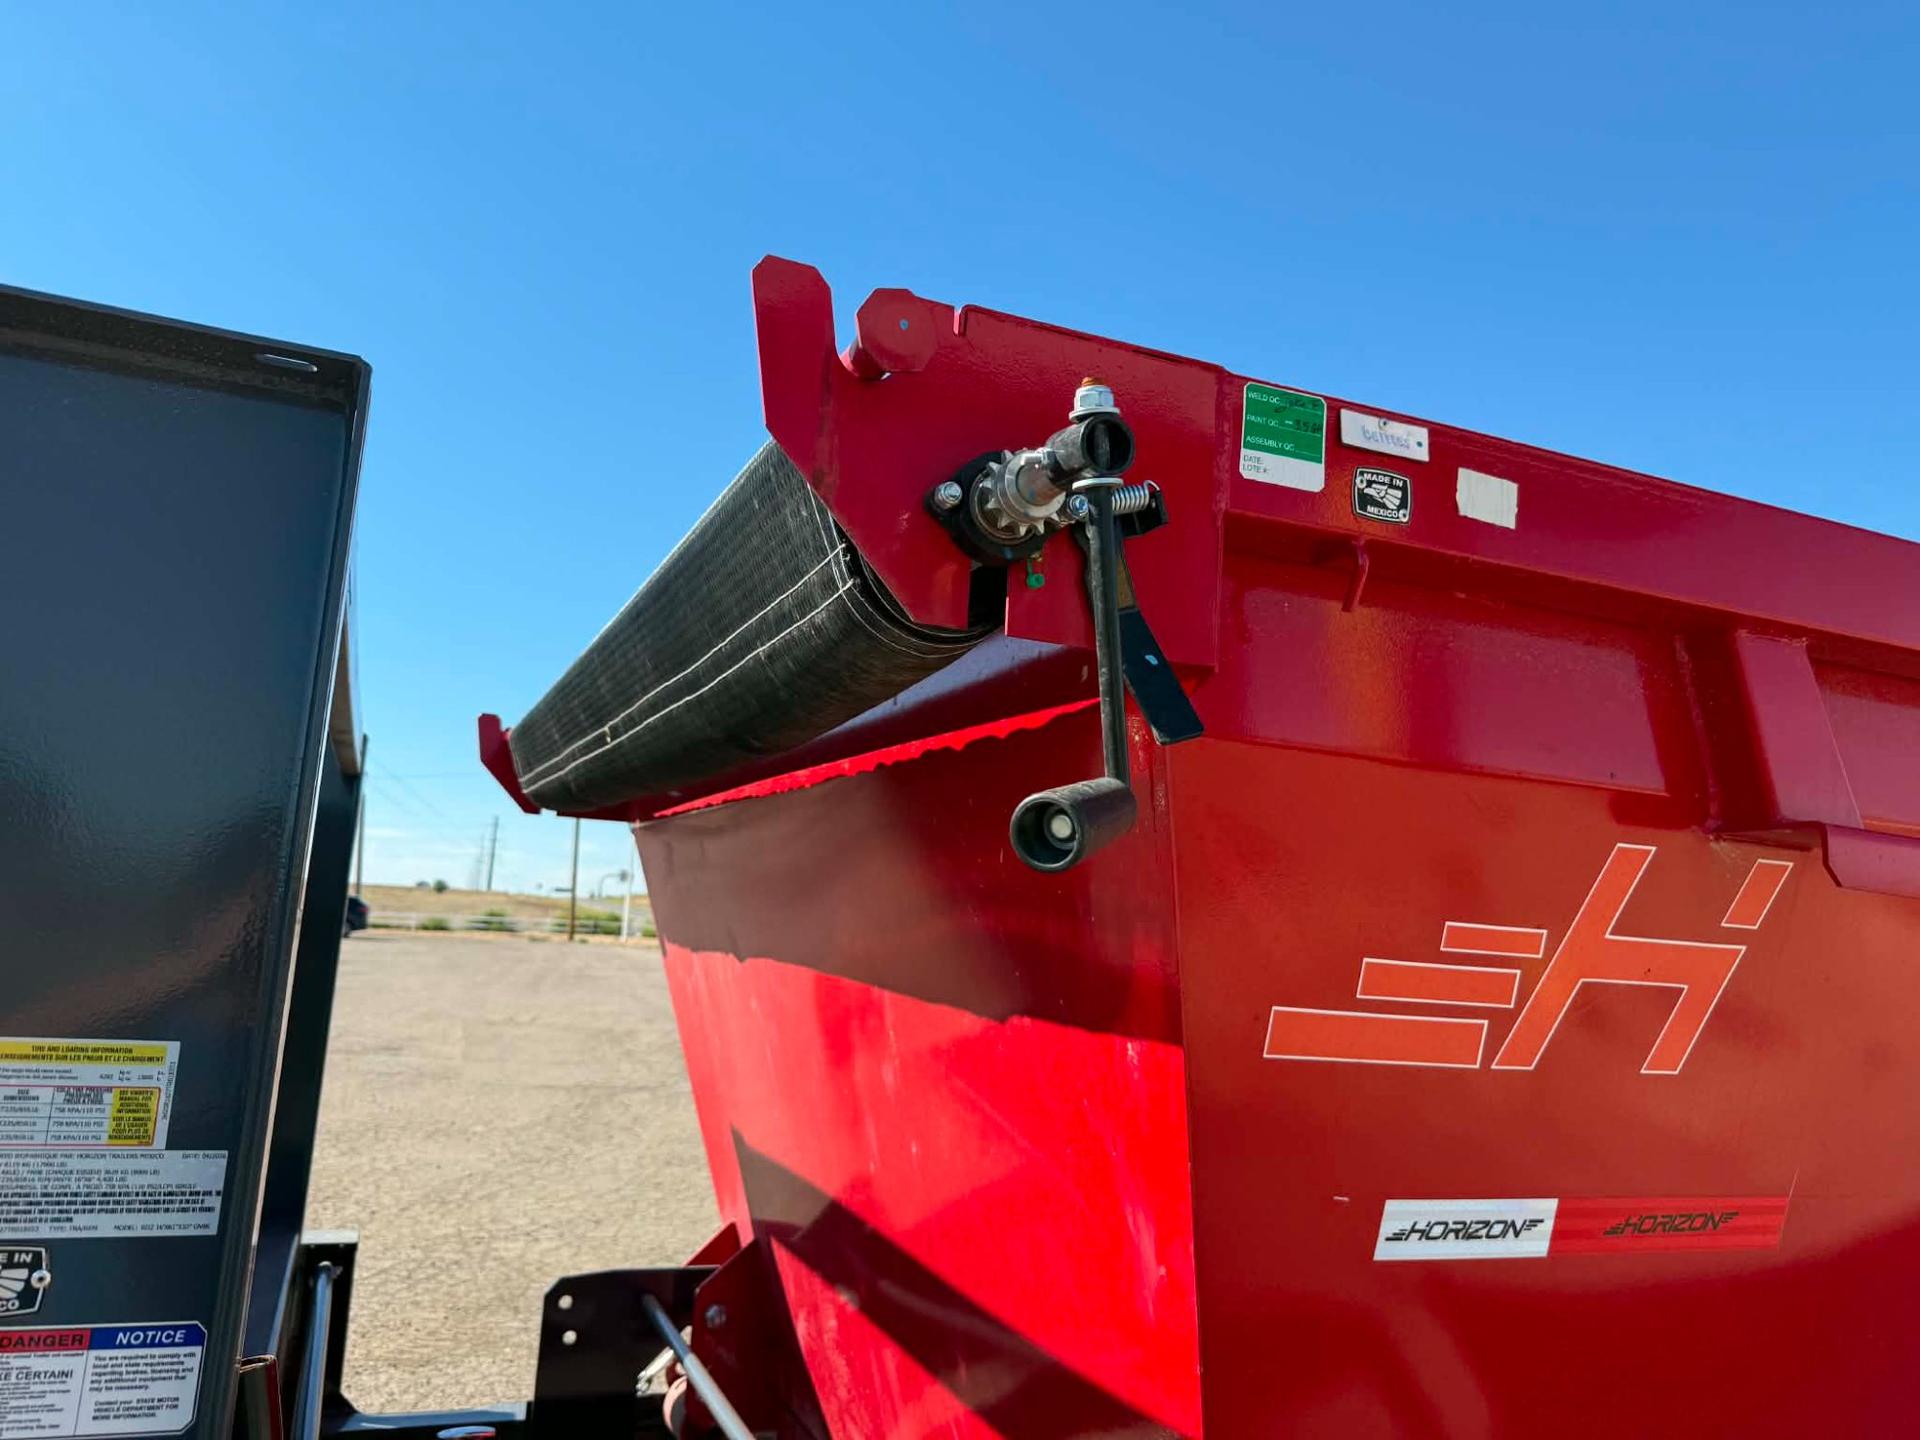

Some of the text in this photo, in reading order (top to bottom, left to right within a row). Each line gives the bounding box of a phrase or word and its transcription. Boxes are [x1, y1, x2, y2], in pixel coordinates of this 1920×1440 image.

[1247, 391, 1281, 405] WELD QC
[1246, 414, 1279, 427] PAINT QC
[1246, 435, 1295, 451] ASSEMBLY QC
[1363, 472, 1404, 487] MADE IN
[1366, 505, 1398, 518] MEXICO
[1404, 1219, 1524, 1241] HORIZON
[1620, 1213, 1724, 1236] HORIZON
[14, 1252, 33, 1263] IN
[0, 1333, 85, 1348] DANGER
[115, 1330, 187, 1346] NOTICE
[16, 1369, 74, 1381] CERTAIN!
